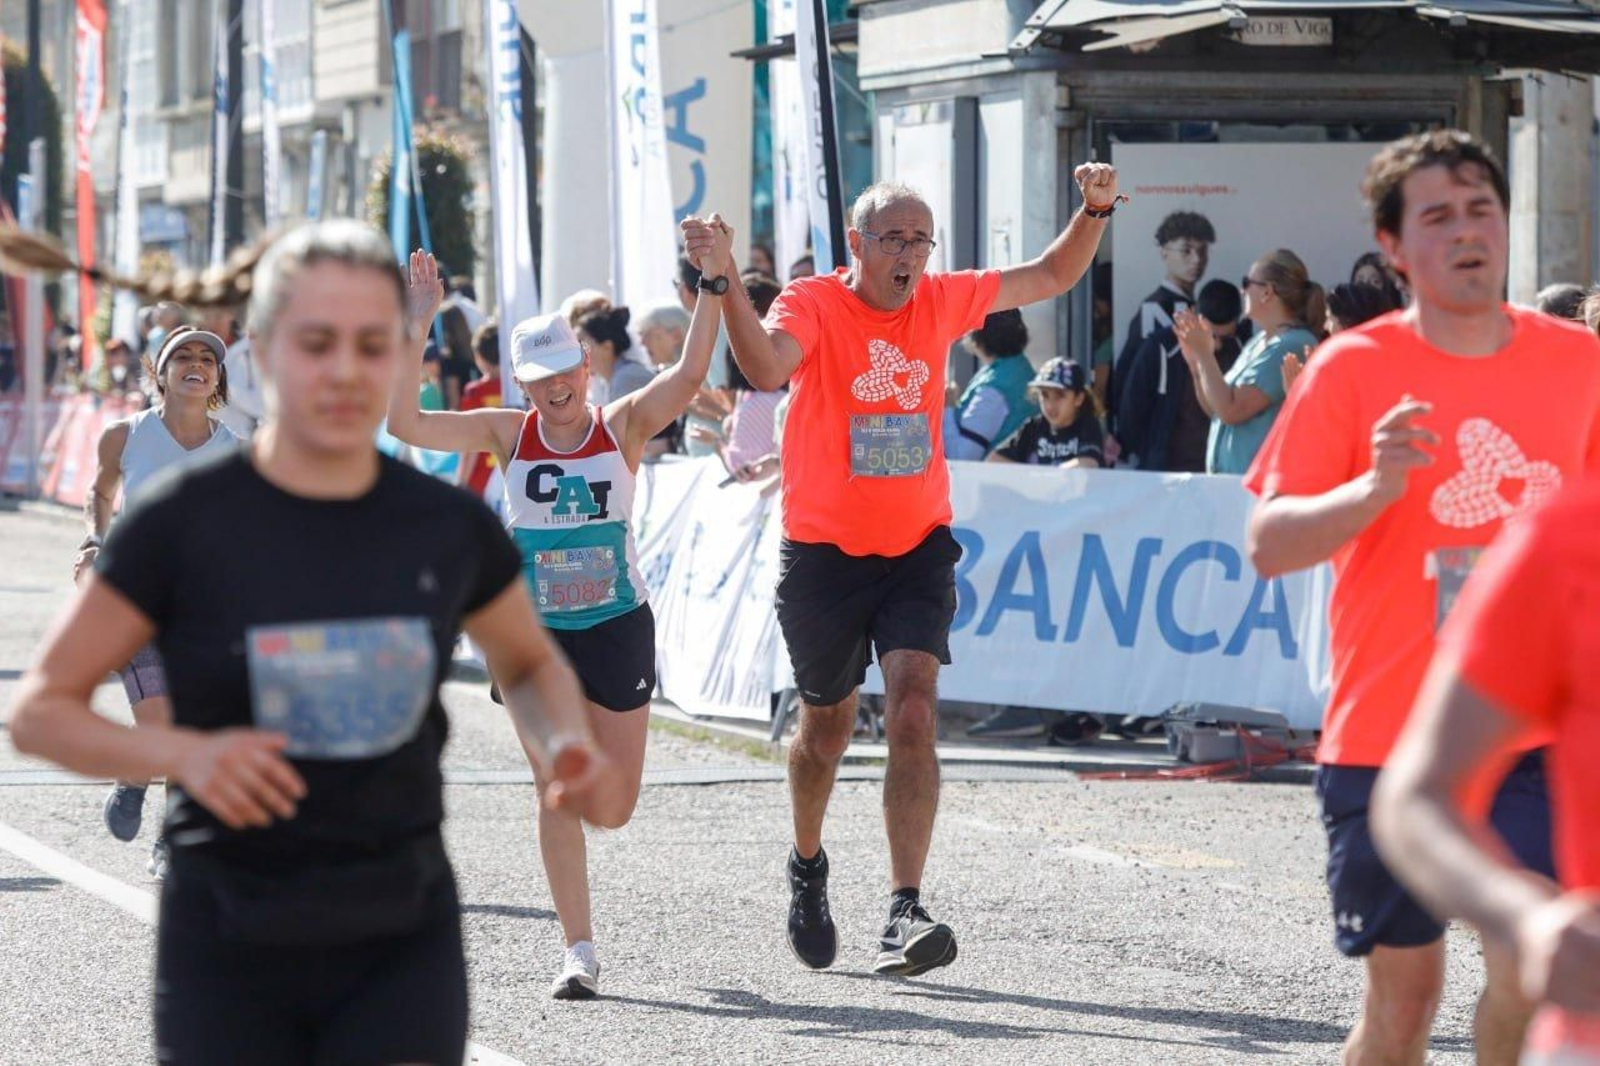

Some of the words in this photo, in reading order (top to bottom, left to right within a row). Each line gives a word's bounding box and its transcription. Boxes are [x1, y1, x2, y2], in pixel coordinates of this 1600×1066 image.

[1267, 21, 1287, 35] DE
[885, 415, 911, 429] BAY
[868, 446, 924, 469] 5053
[567, 549, 593, 563] BAY
